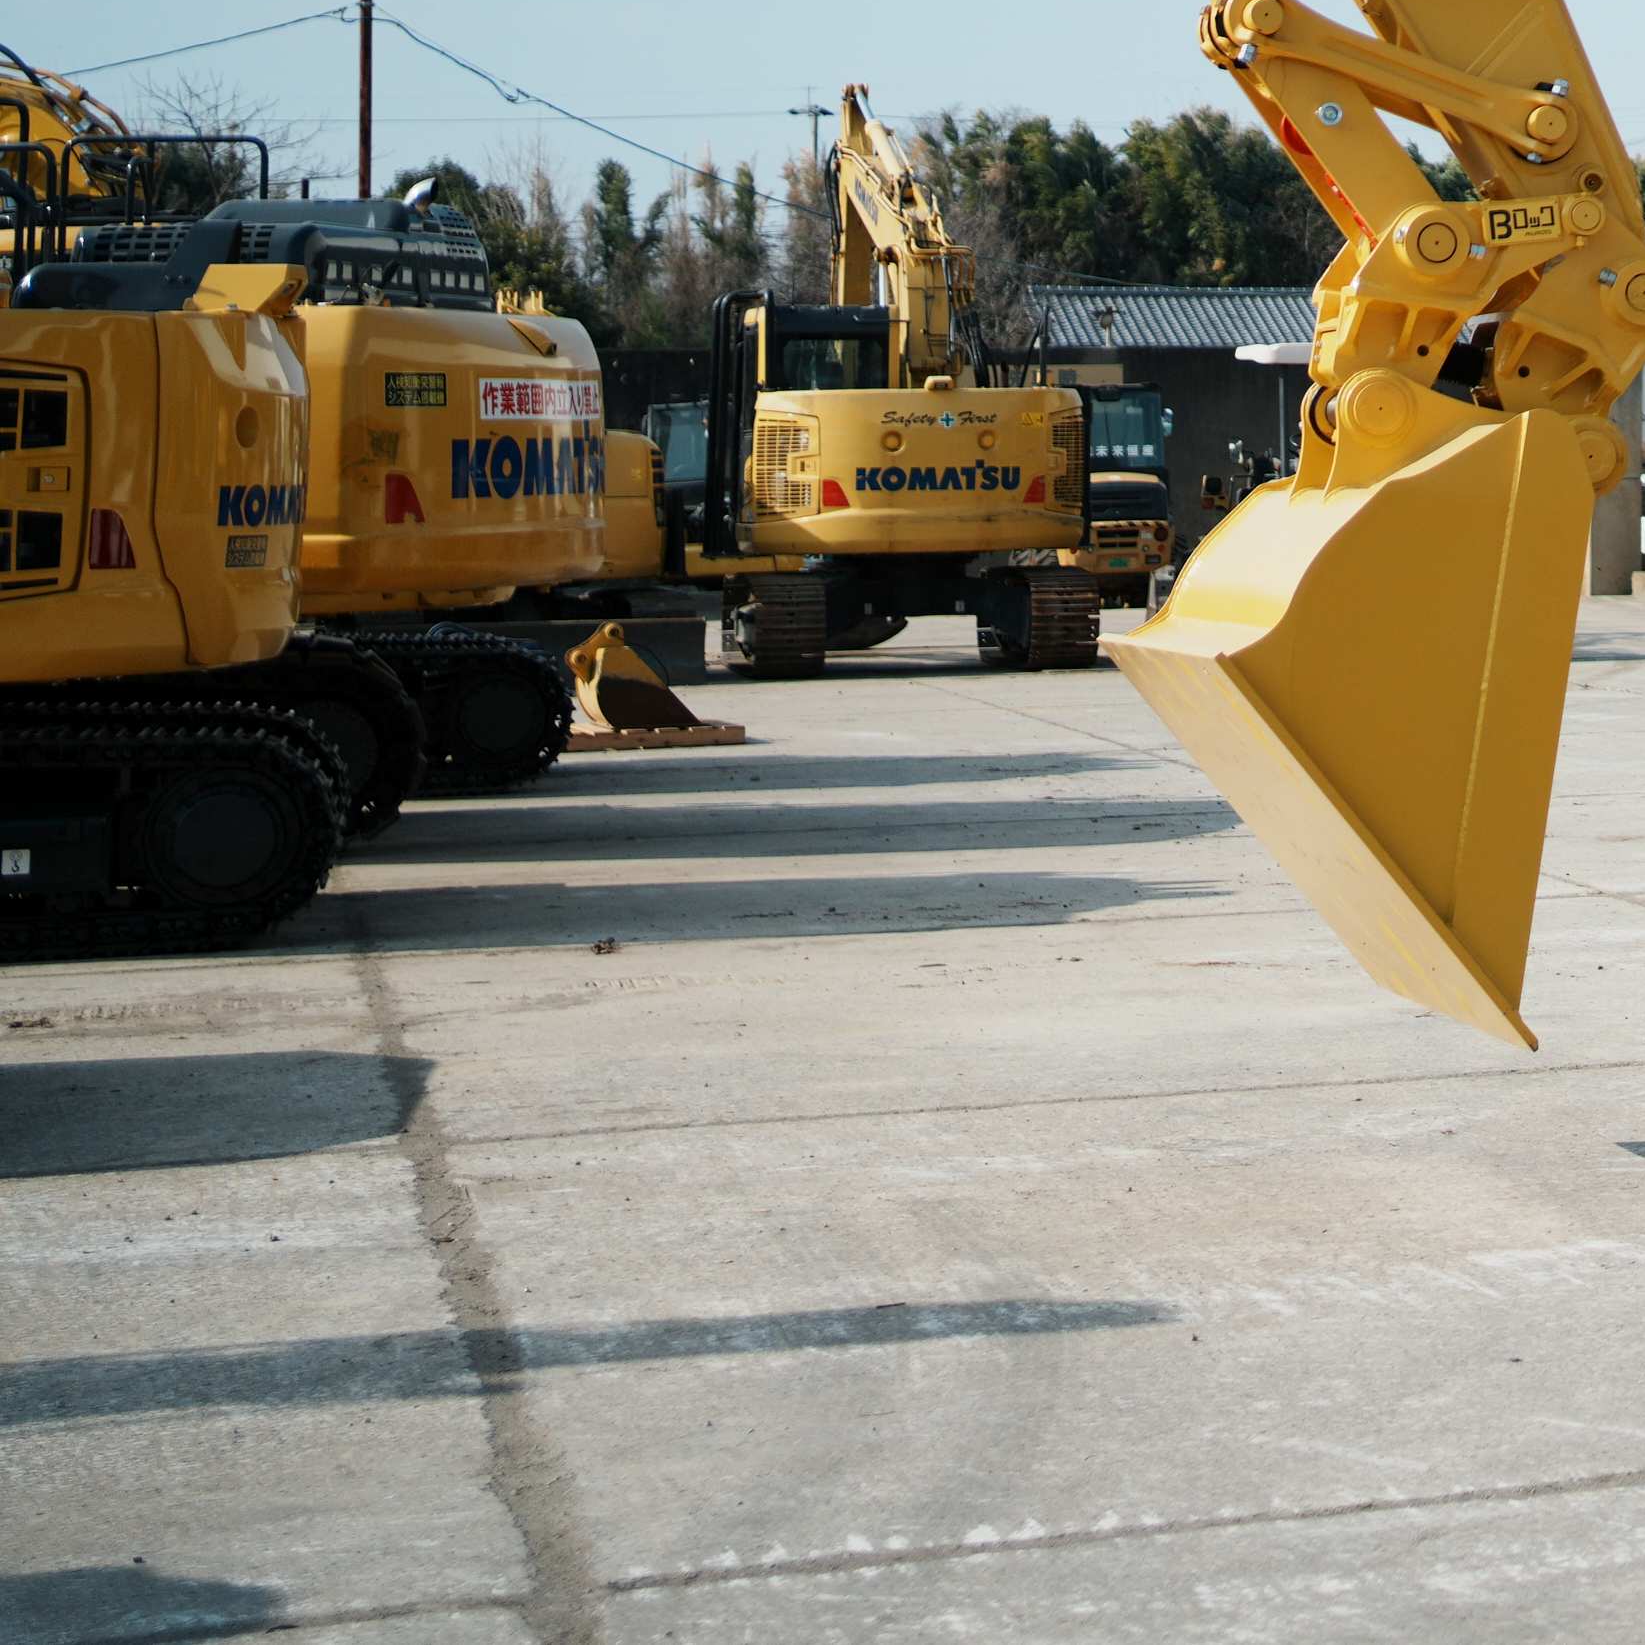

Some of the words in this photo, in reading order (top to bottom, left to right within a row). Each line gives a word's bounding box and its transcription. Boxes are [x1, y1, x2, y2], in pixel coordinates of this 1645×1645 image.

[880, 411, 937, 427] Safety
[958, 411, 997, 425] First
[855, 459, 1021, 491] KOMATSU
